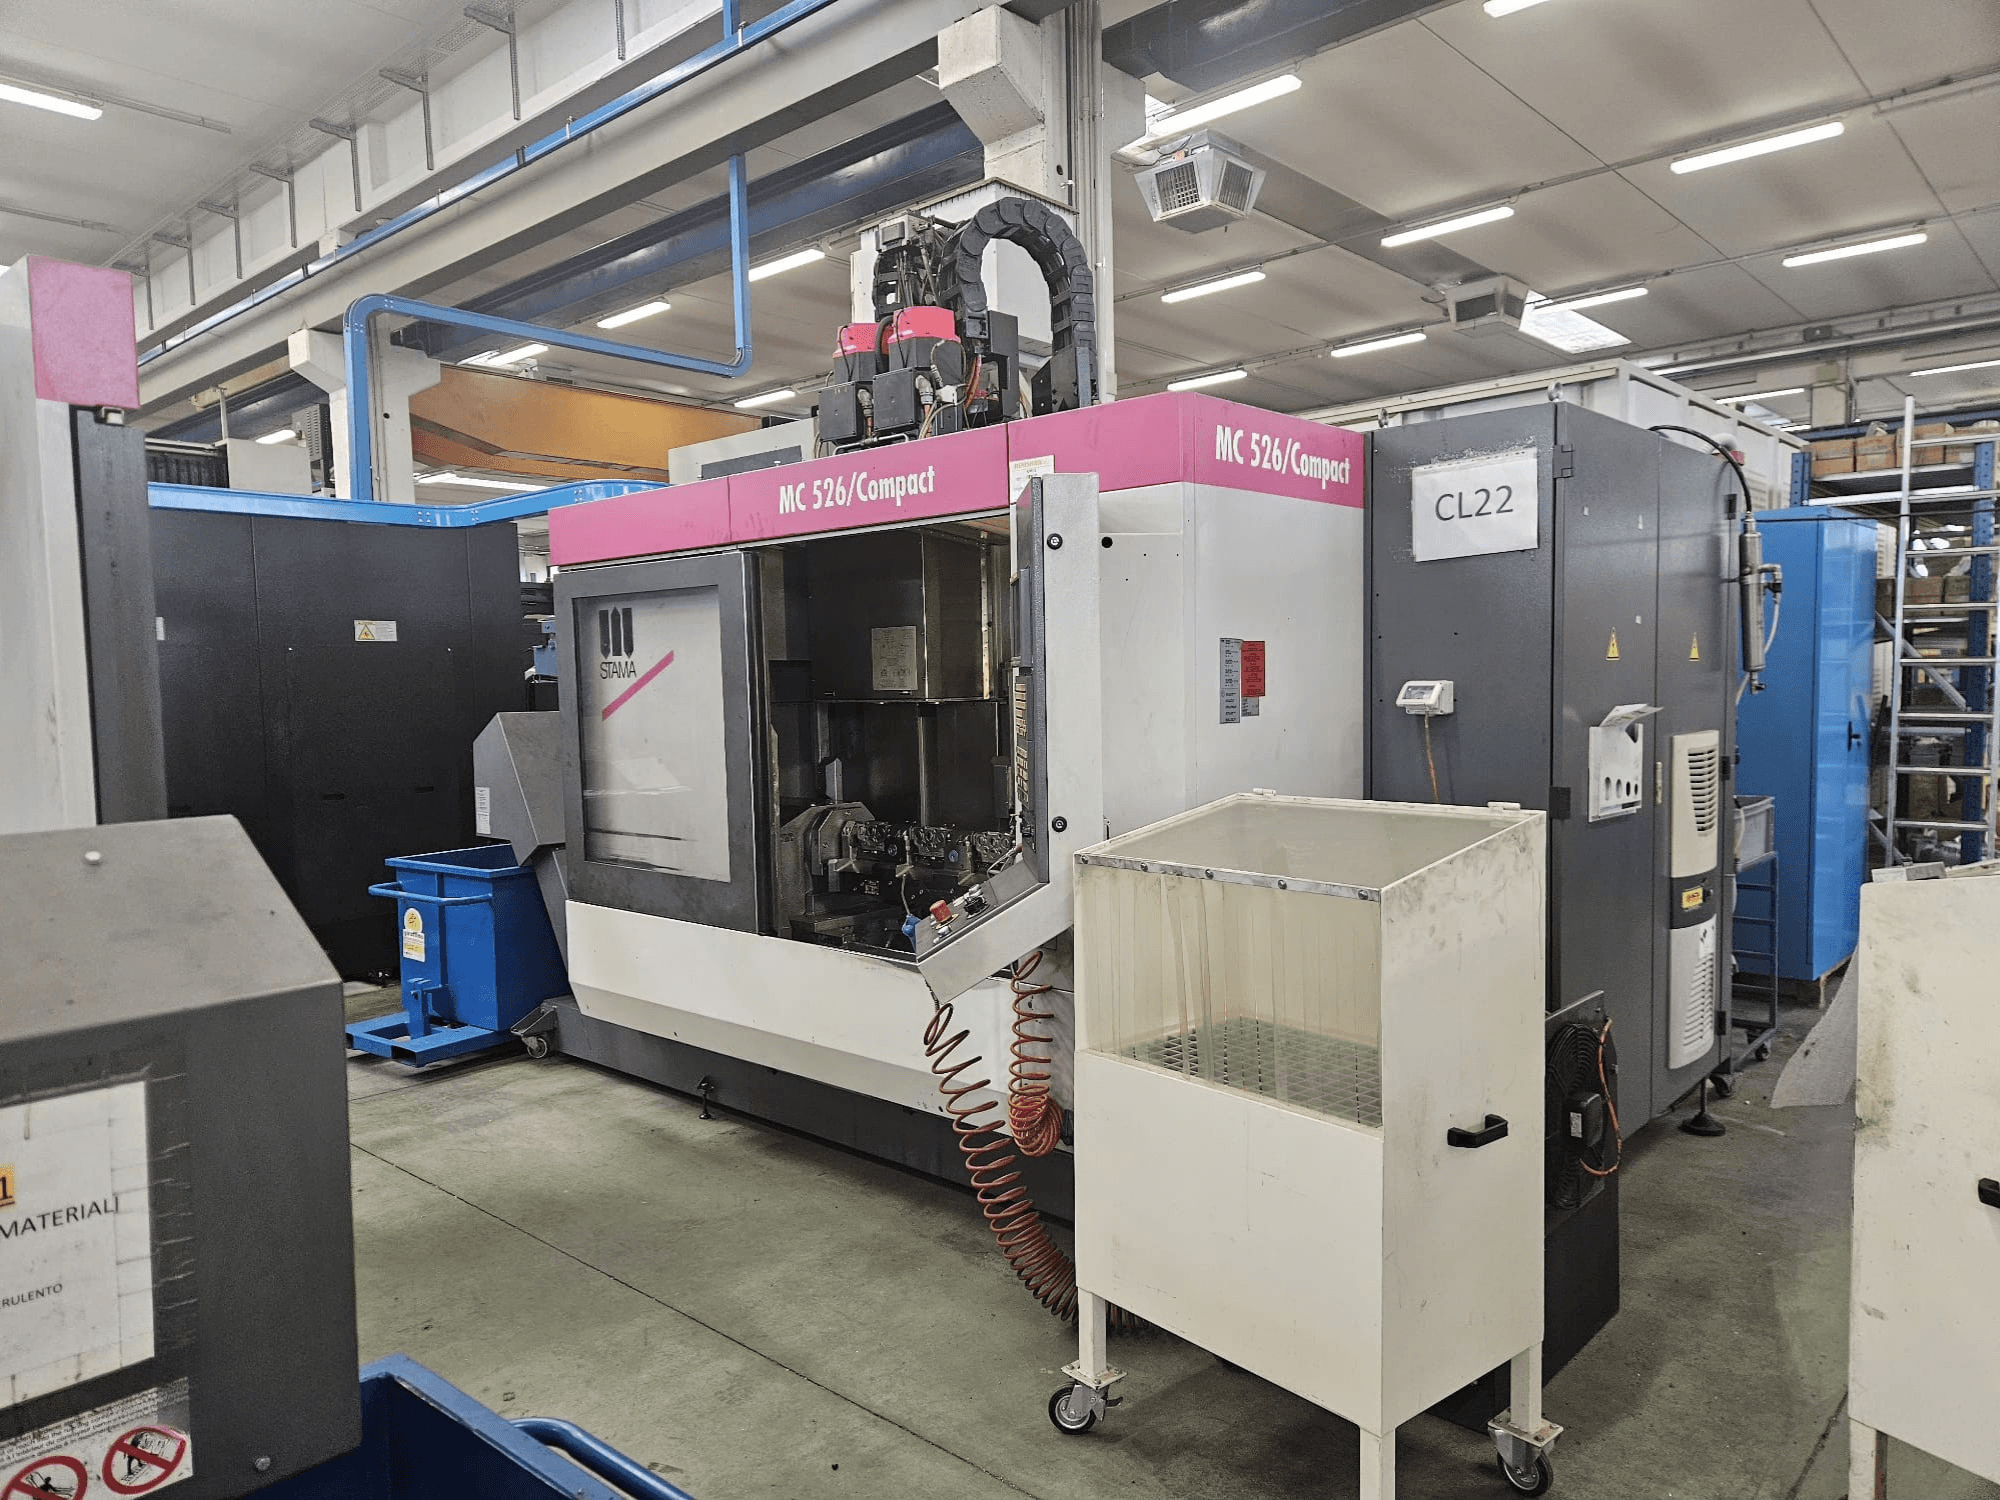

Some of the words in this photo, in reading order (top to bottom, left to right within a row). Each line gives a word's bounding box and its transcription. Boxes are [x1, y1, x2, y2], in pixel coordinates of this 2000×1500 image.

[1215, 424, 1244, 465] MC
[1250, 432, 1350, 490] 526/Compact
[779, 482, 806, 514] MC
[812, 465, 936, 512] 526/Compact
[1435, 485, 1514, 522] CL22
[600, 661, 637, 680] STAMA
[0, 1283, 63, 1310] RULENTO
